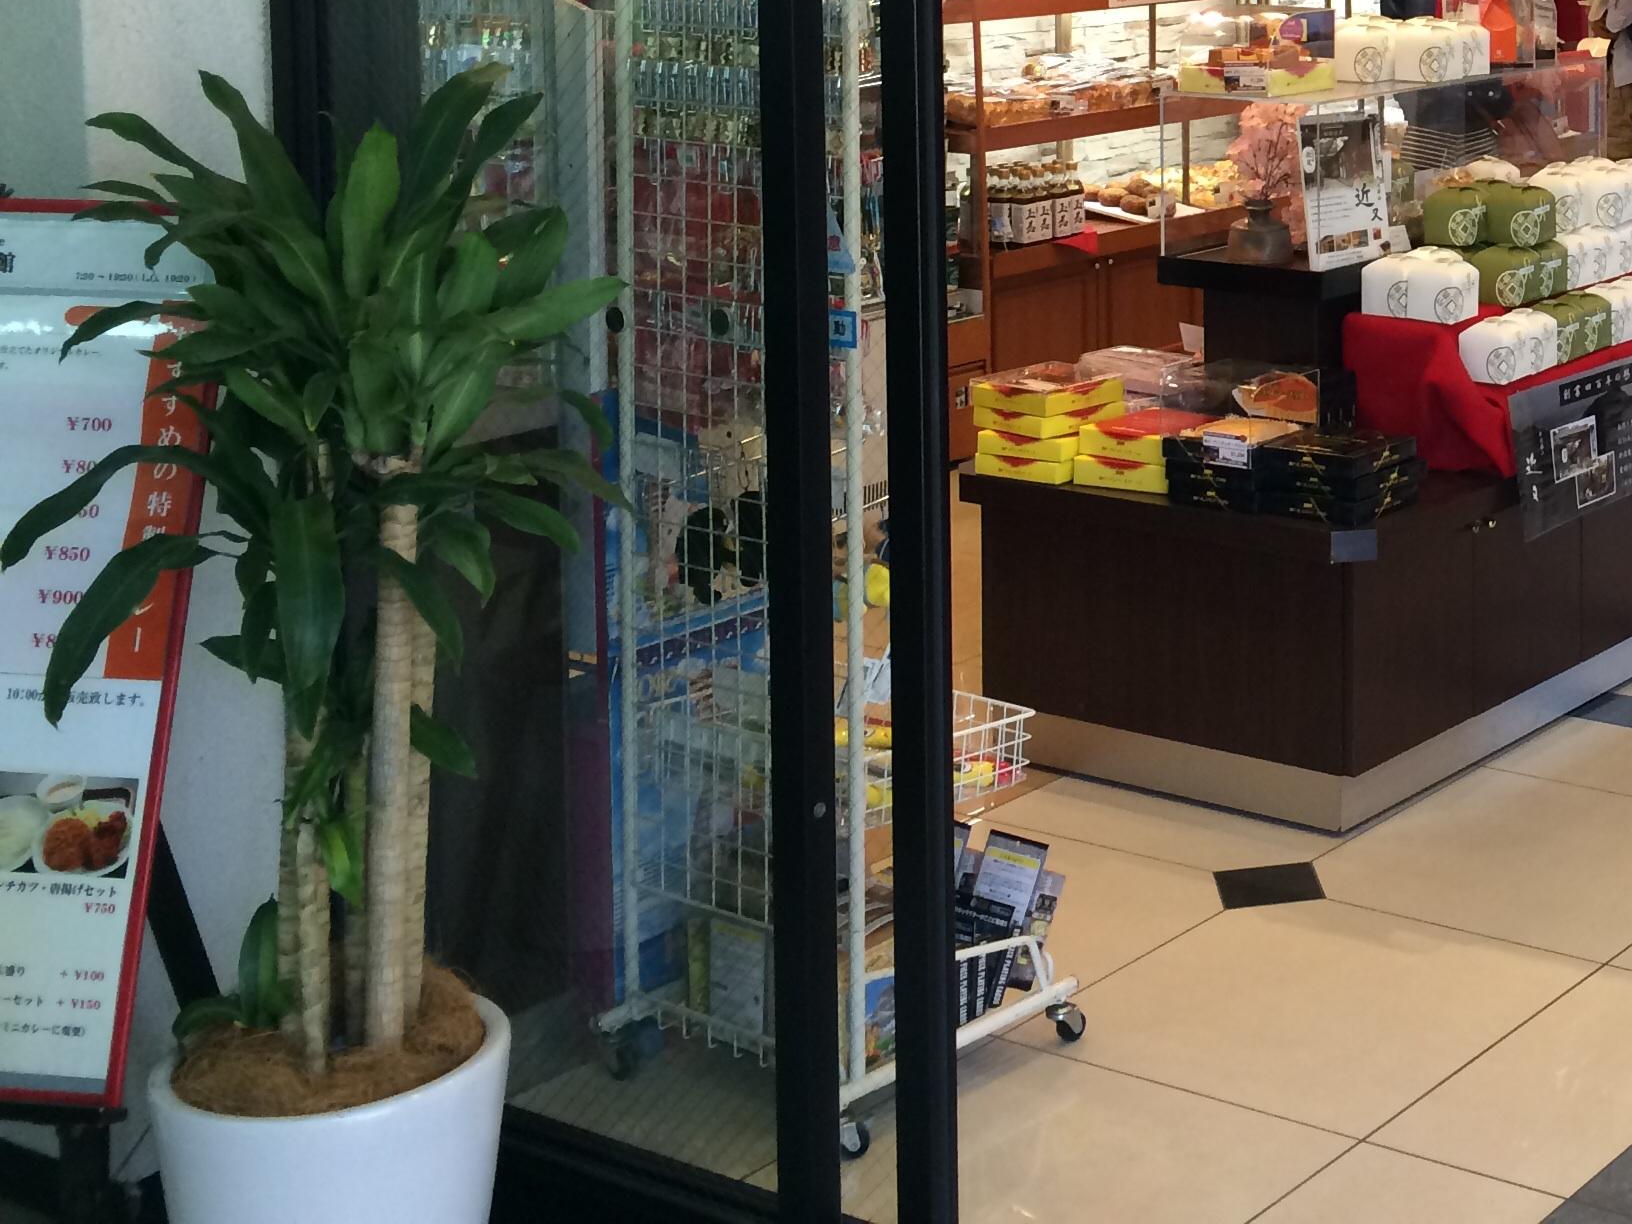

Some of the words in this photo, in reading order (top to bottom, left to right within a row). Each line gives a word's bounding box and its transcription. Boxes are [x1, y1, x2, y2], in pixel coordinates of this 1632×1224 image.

[1355, 183, 1383, 221] 近又
[67, 416, 112, 432] ¥700
[61, 459, 98, 474] ¥80
[45, 545, 90, 562] ¥850
[75, 970, 105, 981] ¥100
